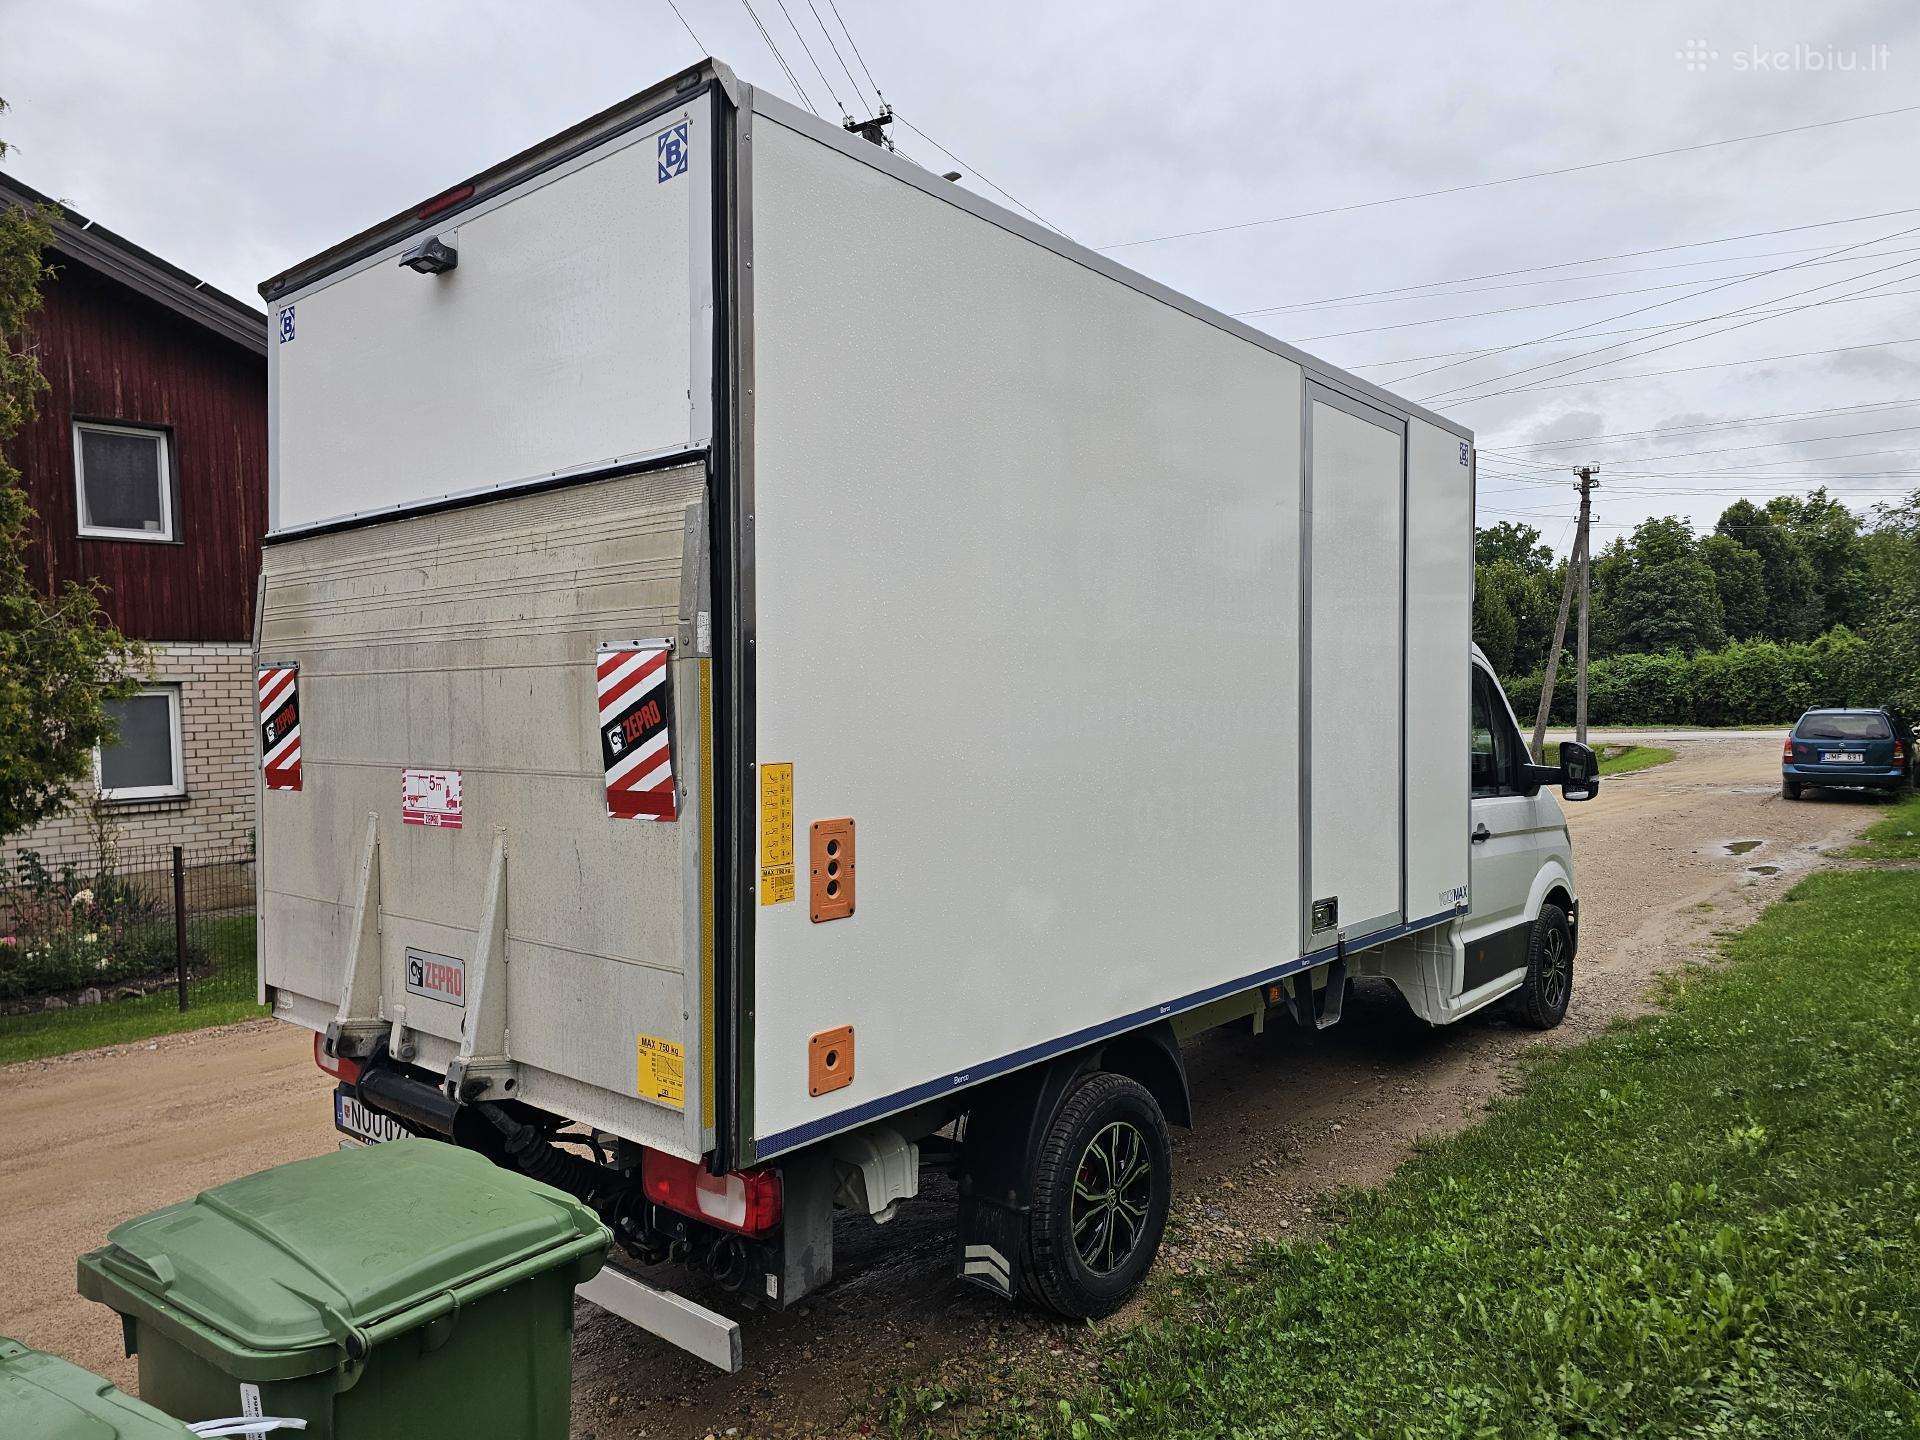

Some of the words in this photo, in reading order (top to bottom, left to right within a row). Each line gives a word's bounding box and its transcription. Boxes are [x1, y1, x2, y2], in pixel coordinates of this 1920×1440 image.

[274, 703, 296, 736] ZEPRO
[622, 699, 661, 743] ZEPRO
[424, 960, 462, 998] ZEPRO
[641, 1037, 656, 1049] MAX
[659, 1042, 670, 1053] 750
